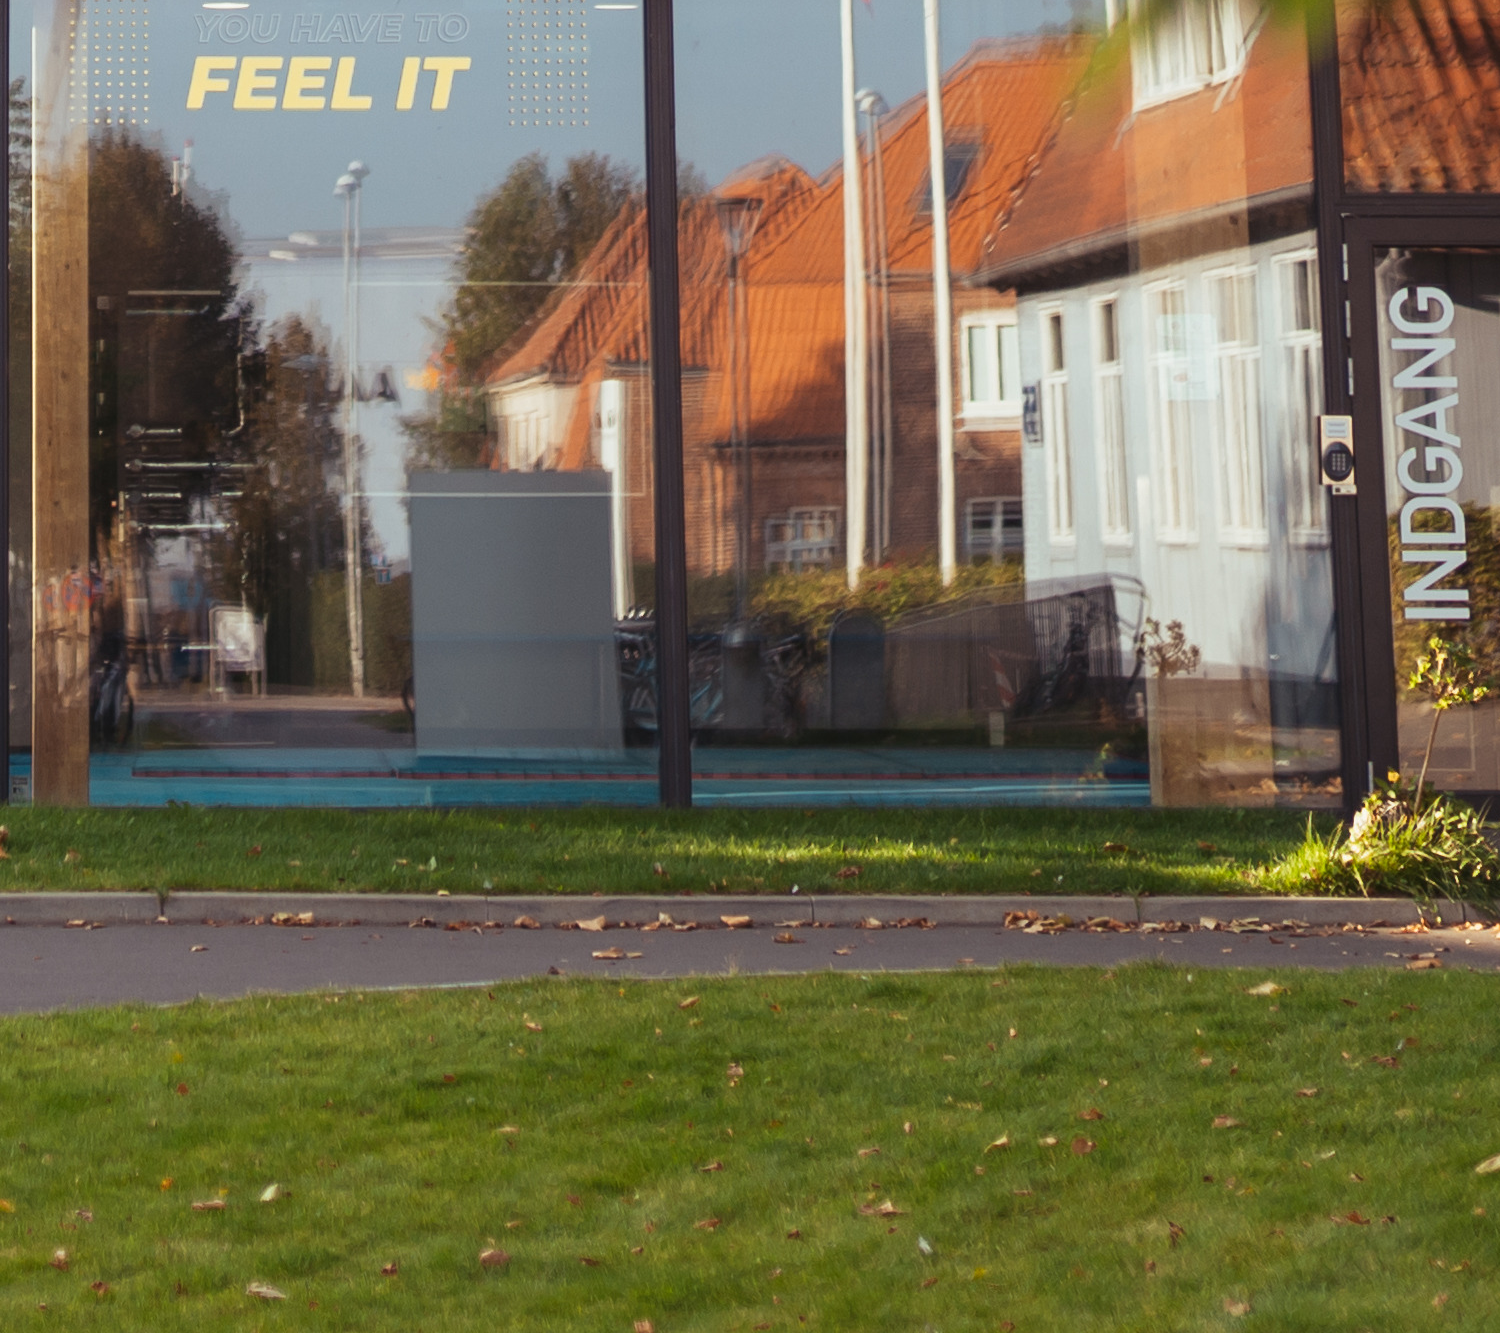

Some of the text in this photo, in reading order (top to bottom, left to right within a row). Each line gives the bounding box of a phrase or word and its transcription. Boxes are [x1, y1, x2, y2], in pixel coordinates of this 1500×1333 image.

[194, 13, 469, 44] YOU HAVE TO
[186, 55, 472, 111] FEEL IT
[1388, 286, 1471, 621] INDGANG
